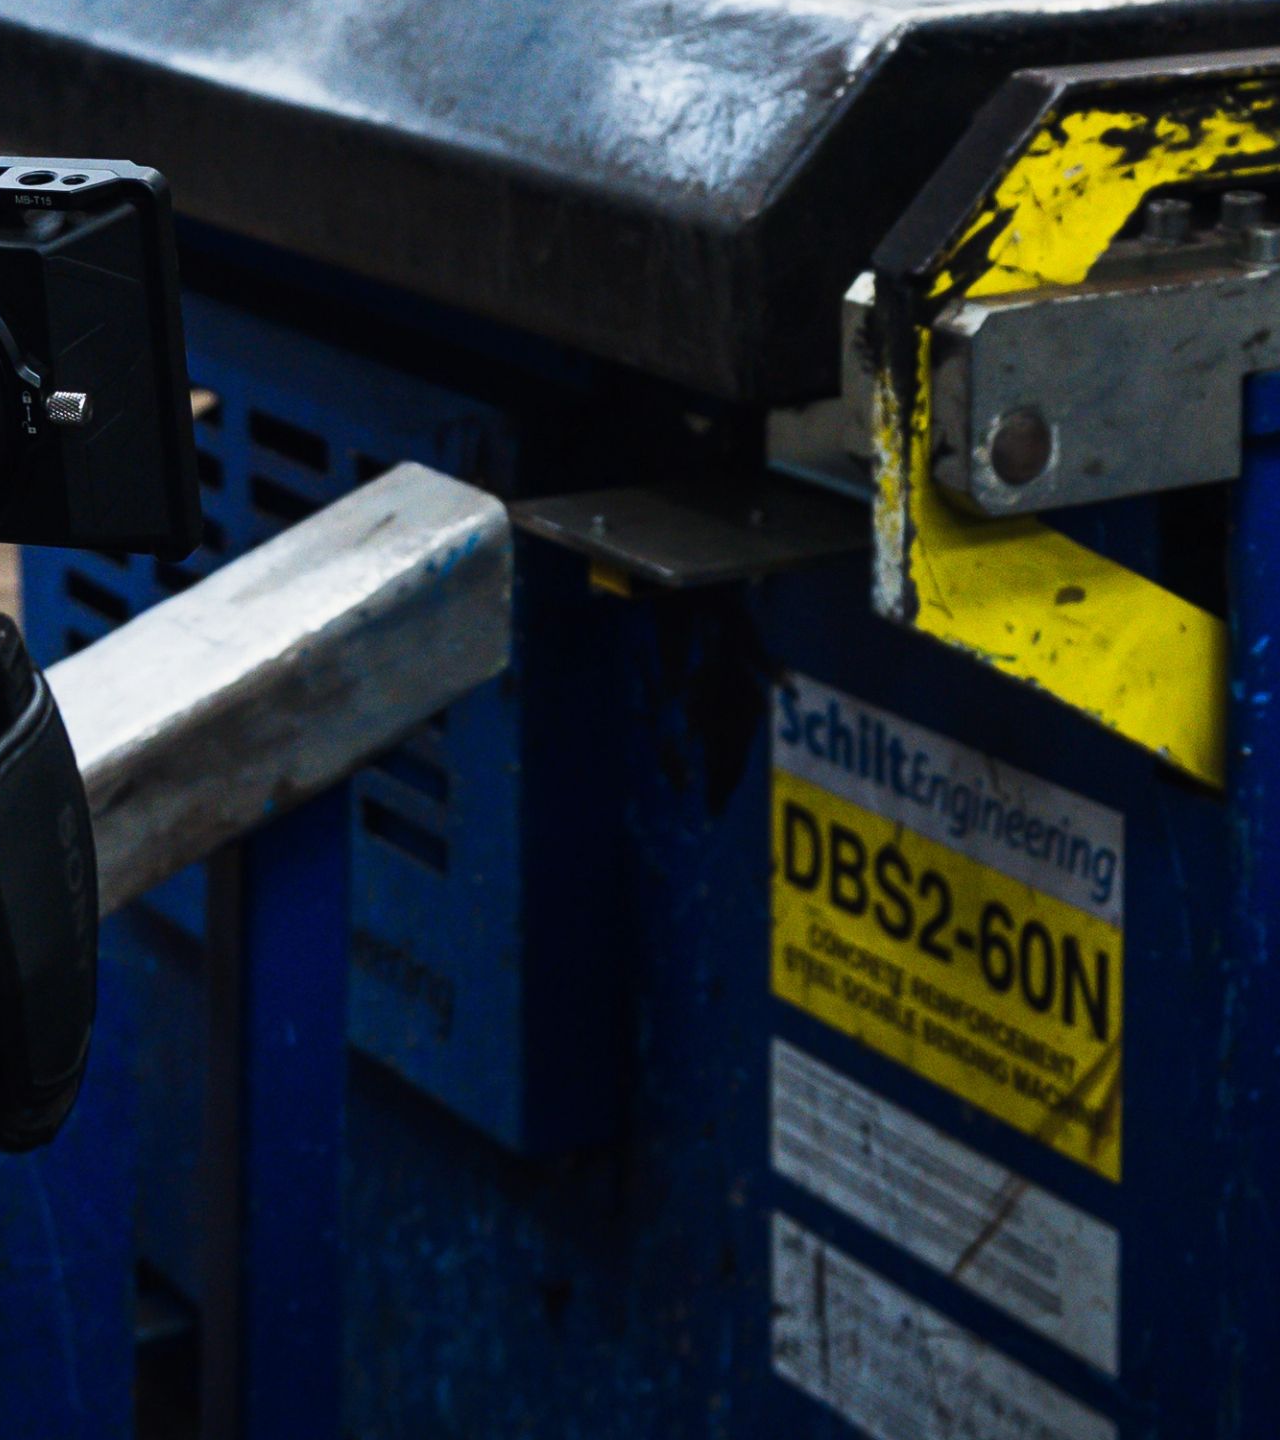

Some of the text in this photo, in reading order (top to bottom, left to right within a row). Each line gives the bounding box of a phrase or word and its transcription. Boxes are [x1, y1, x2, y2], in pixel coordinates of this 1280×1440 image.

[14, 194, 53, 207] MB-T15
[784, 801, 1109, 1042] DBS2-60N
[807, 923, 903, 1000] CONCRETE
